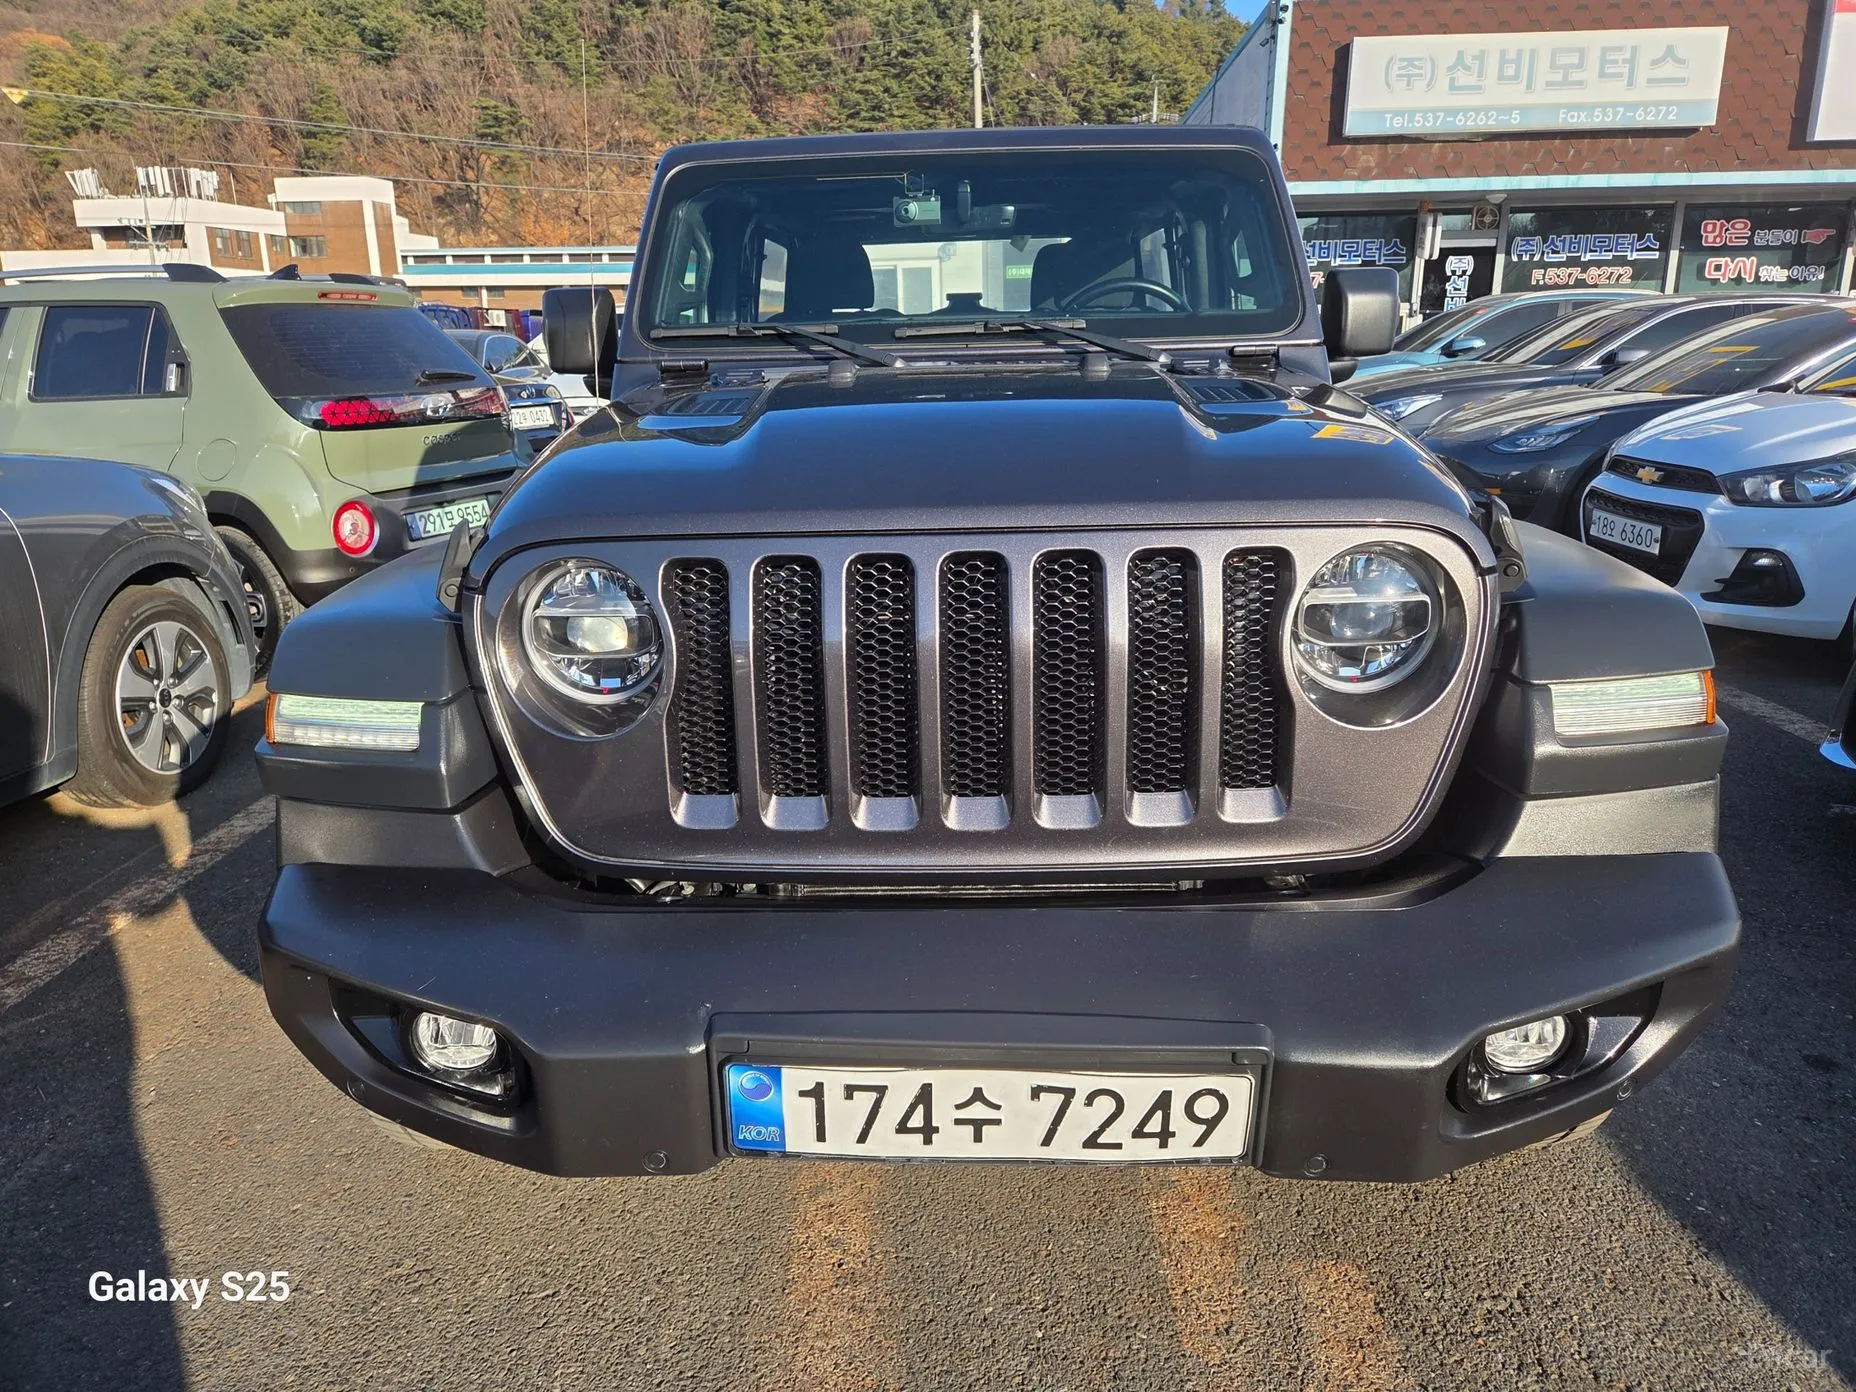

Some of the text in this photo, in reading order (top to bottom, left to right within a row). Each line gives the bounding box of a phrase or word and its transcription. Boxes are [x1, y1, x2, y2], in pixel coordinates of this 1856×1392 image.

[1384, 43, 1689, 94] (주)선비모터스
[1385, 110, 1521, 127] Tel.537-6262~5
[1558, 105, 1678, 123] Fax.537-6272
[1701, 219, 1751, 247] 많은
[1511, 233, 1660, 261] (주)선비모터스
[1531, 267, 1633, 286] F.537-6272
[1705, 257, 1757, 283] 다시
[738, 1125, 780, 1142] KOR
